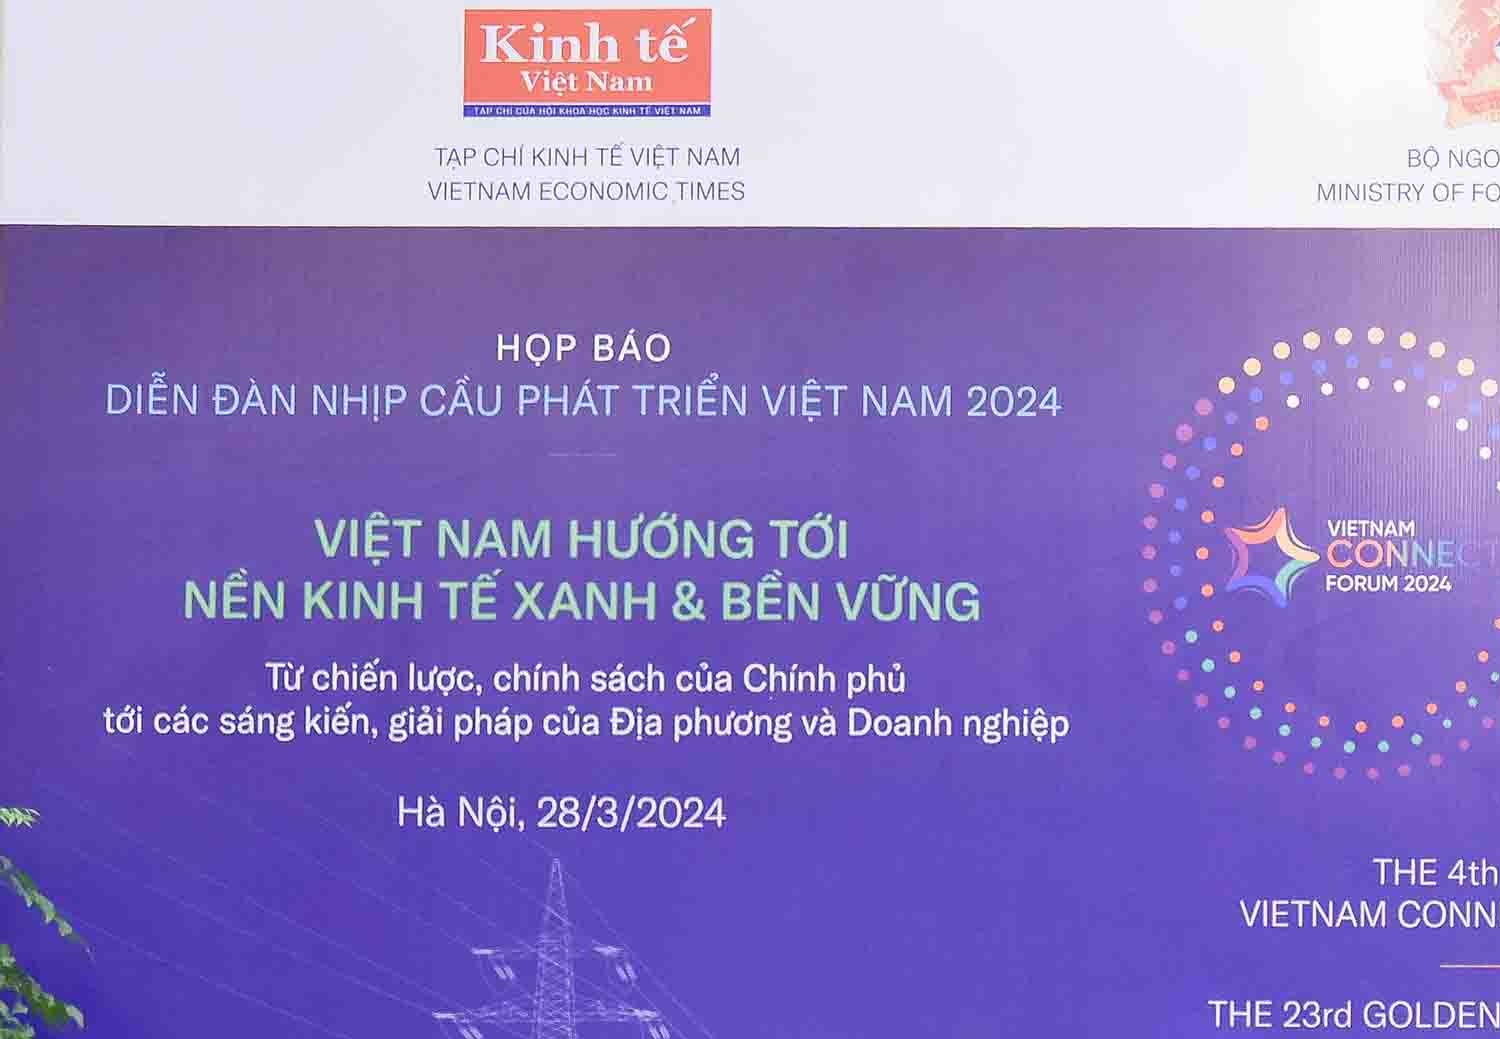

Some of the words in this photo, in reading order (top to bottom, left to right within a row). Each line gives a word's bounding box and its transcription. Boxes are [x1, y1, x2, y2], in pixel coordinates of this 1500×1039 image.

[479, 21, 621, 64] Kinh
[634, 16, 697, 63] tế
[519, 69, 579, 97] Việt
[586, 70, 653, 92] Nam
[434, 147, 477, 171] TẠP
[483, 143, 524, 167] CHÍ
[532, 147, 588, 167] KINH
[595, 138, 625, 167] TẾ
[629, 143, 680, 171] VIỆT
[687, 146, 740, 167] NAM
[1407, 145, 1440, 172] BỘ
[427, 181, 531, 201] VIETNAM
[539, 181, 668, 201] ECONOMIC
[675, 180, 745, 201] TIMES
[1317, 182, 1425, 202] MINISTRY
[1432, 182, 1465, 203] OF
[497, 333, 577, 367] HỌP
[593, 327, 671, 363] BÁO
[106, 371, 198, 415] DIỄN
[211, 377, 296, 416] ĐÀN
[312, 383, 407, 422] NHỊP
[419, 375, 502, 417] CẦU
[518, 378, 620, 417] PHÁT
[631, 372, 747, 417] TRIỂN
[761, 378, 848, 423] VIỆT
[862, 383, 952, 417] NAM
[967, 385, 1062, 417] 2024
[314, 511, 423, 567] VIỆT
[437, 519, 551, 559] NAM
[569, 511, 754, 560] HƯỚNG
[768, 511, 848, 560] TỚI
[1327, 519, 1416, 538] VIETNAM
[184, 567, 285, 620] NỀN
[303, 580, 423, 621] KINH
[438, 568, 502, 621] TẾ
[512, 581, 656, 621] XANH
[671, 580, 706, 621] &
[722, 568, 819, 622] BỀN
[835, 573, 980, 622] VỮNG
[1326, 574, 1398, 593] FORUM
[1403, 575, 1453, 593] 2024
[264, 661, 305, 691] Từ
[311, 657, 398, 692] chiến
[409, 662, 483, 697] lược,
[493, 662, 580, 692] chính
[590, 663, 665, 693] sách
[675, 661, 733, 693] của
[743, 663, 836, 693] Chính
[847, 662, 906, 700] phủ
[102, 704, 143, 734] tới
[153, 703, 209, 735] các
[219, 705, 296, 742] sáng
[305, 701, 378, 739] kiến,
[388, 704, 443, 743] giải
[454, 706, 533, 743] pháp
[542, 705, 600, 736] của
[609, 706, 662, 741] Địa
[673, 706, 793, 743] phương
[801, 707, 837, 737] và
[848, 707, 952, 737] Doanh
[963, 707, 1070, 744] nghiệp
[398, 795, 445, 828] Hà
[459, 795, 525, 833] Nội,
[537, 794, 727, 833] 28/3/2024
[1372, 858, 1437, 886] THE
[1447, 857, 1498, 886] 4th
[1239, 899, 1387, 928] VIETNAM
[1207, 999, 1273, 1028] THE
[1282, 999, 1352, 1029] 23rd
[1363, 999, 1500, 1029] GOLDEN
